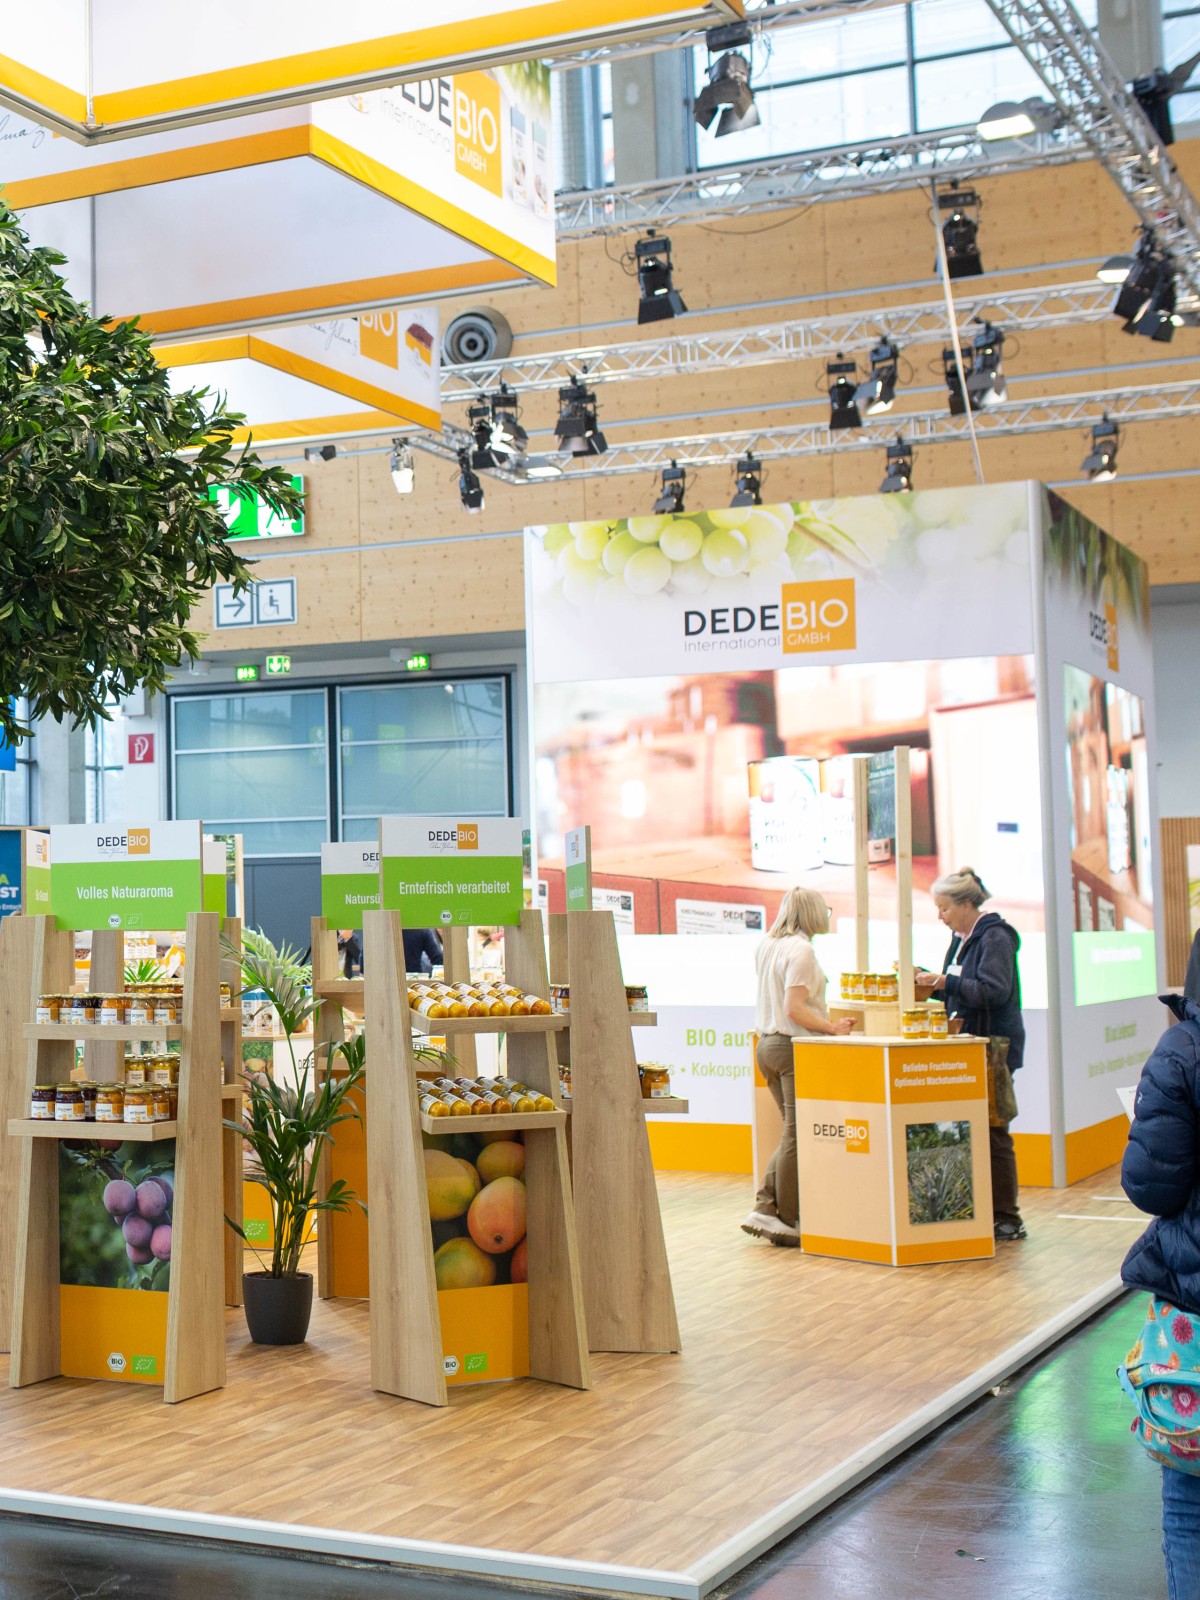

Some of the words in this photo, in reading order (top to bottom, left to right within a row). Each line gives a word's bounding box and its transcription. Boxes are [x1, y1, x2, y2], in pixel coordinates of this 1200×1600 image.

[684, 636, 781, 653] International
[787, 631, 831, 647] GMBH
[76, 885, 109, 900] Volles
[111, 885, 174, 899] Naturaroma
[399, 880, 454, 896] Erntefrisch
[456, 880, 511, 895] verarbeitet
[686, 1029, 717, 1046] BIO
[111, 1357, 123, 1365] BIO
[445, 1361, 457, 1369] BIO
